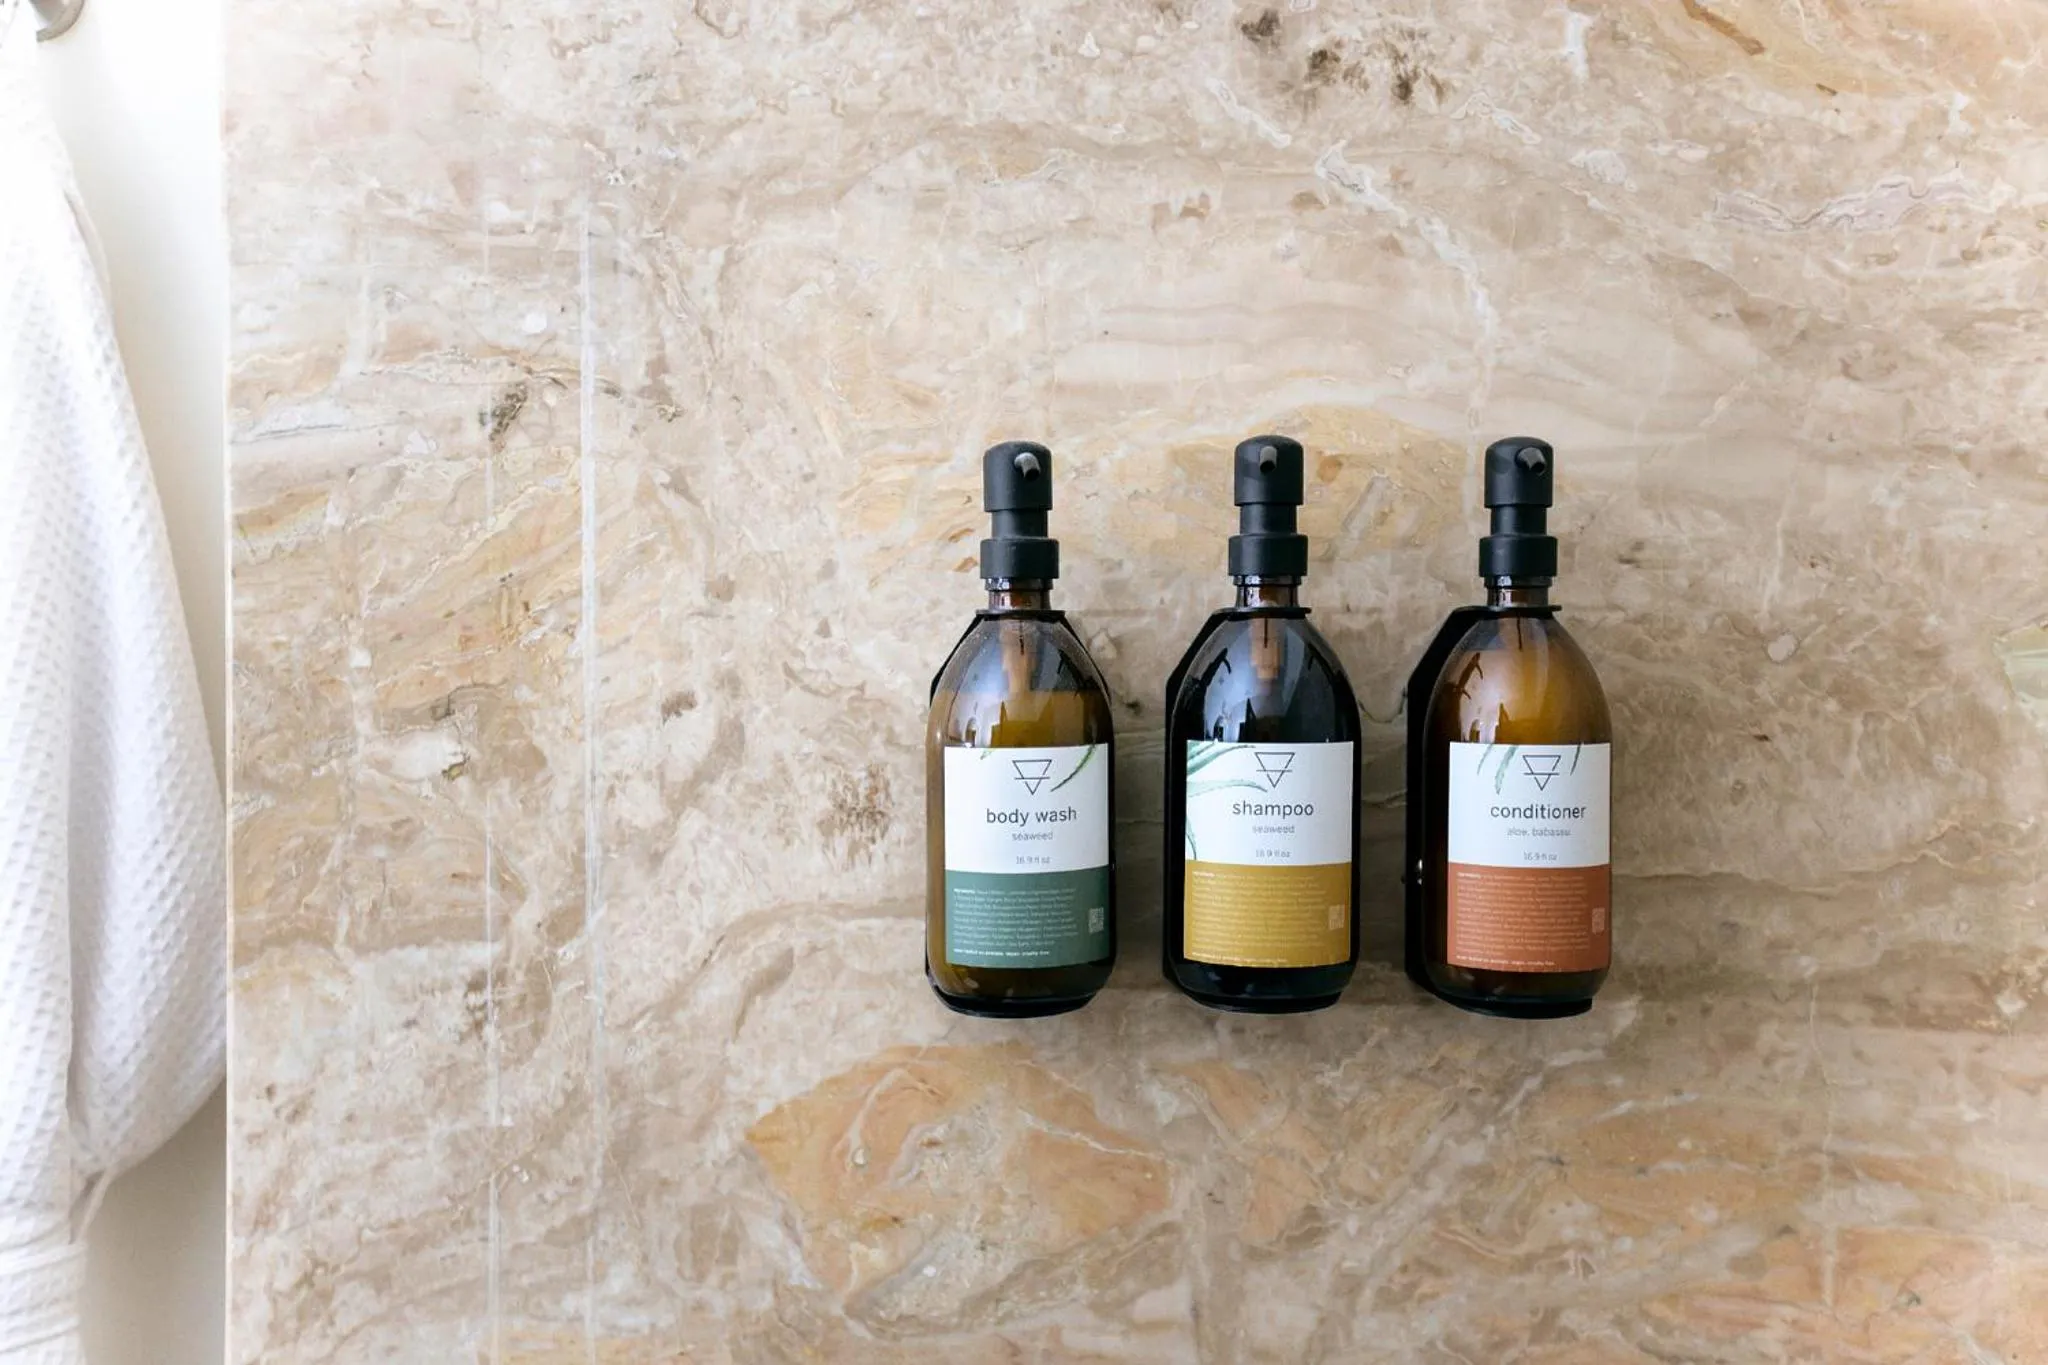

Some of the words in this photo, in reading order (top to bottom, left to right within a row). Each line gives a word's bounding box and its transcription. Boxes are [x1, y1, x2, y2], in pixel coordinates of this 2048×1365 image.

[986, 808, 1029, 827] body
[1035, 806, 1077, 823] wash
[1232, 800, 1314, 820] shampoo
[1490, 804, 1587, 819] conditioner
[1011, 831, 1053, 841] seaweed
